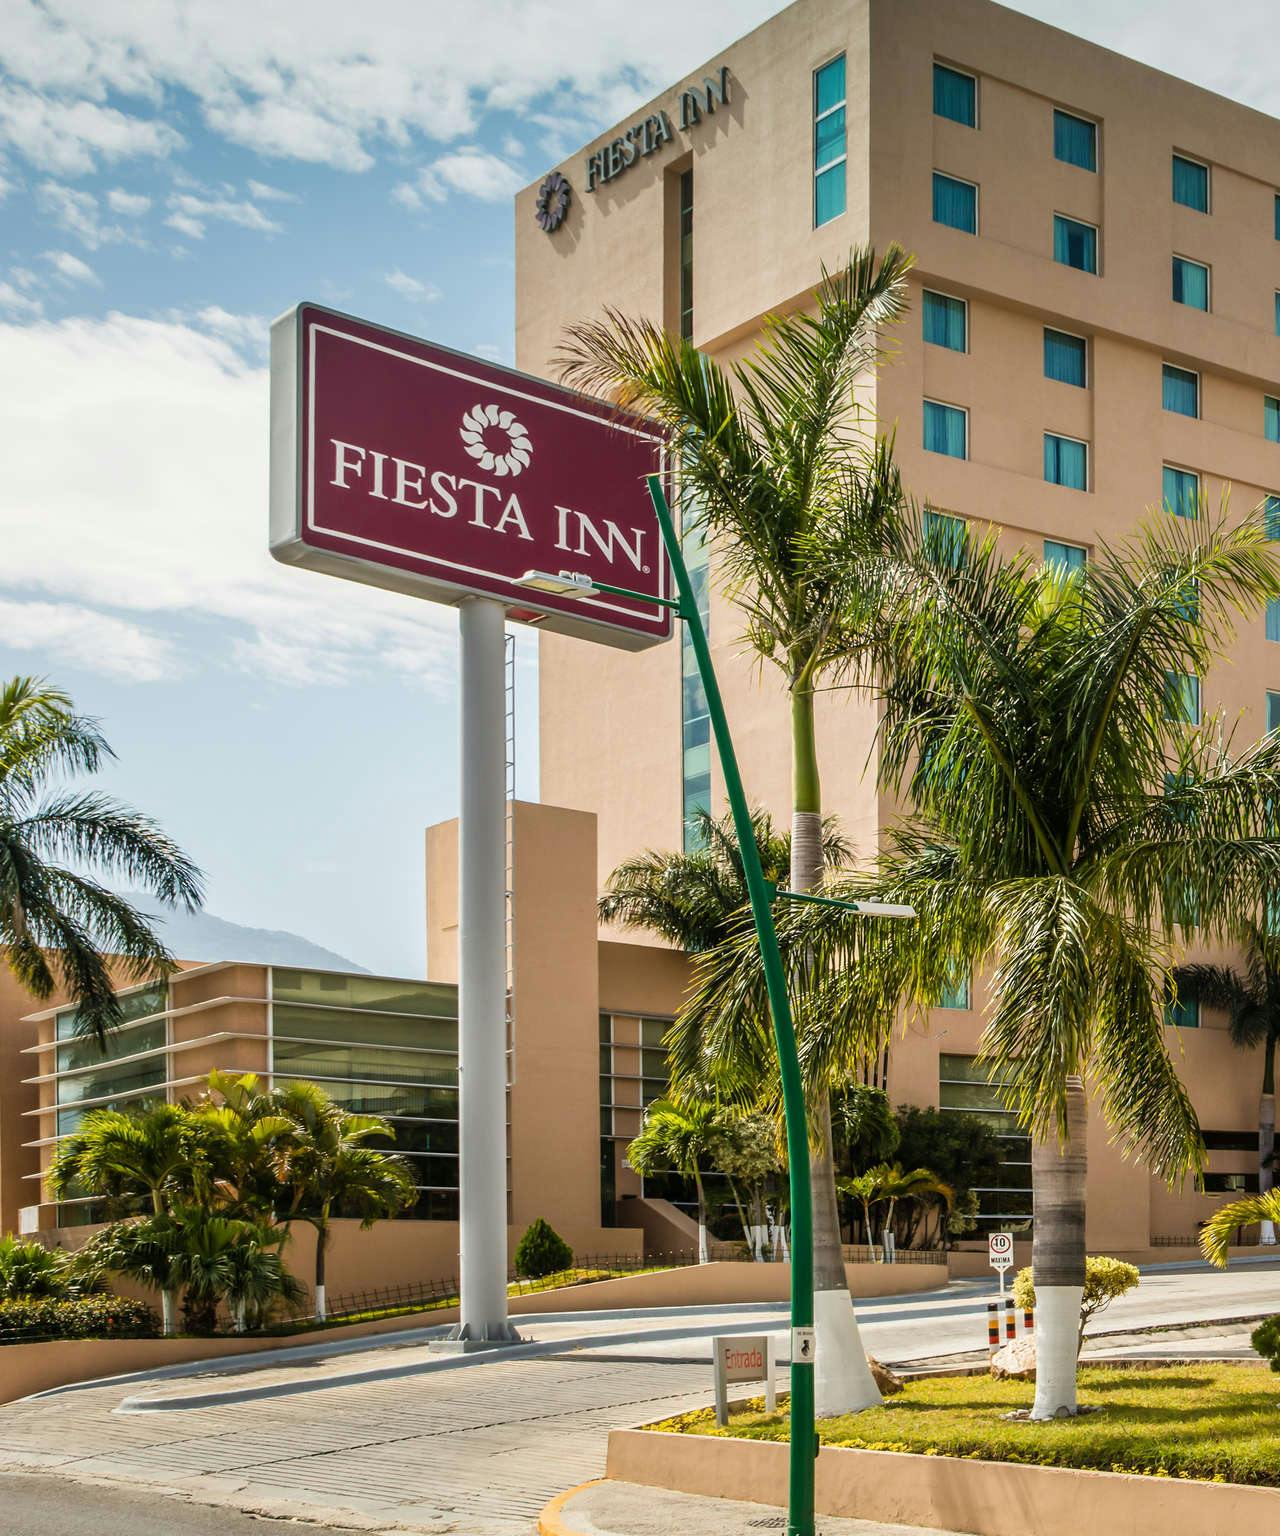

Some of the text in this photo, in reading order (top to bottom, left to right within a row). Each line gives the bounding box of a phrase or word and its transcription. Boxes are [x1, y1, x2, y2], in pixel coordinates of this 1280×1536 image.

[585, 66, 730, 194] FIESTA INN
[329, 438, 535, 542] FIESTA
[994, 1237, 1006, 1248] 10
[724, 1347, 763, 1370] Entrada
